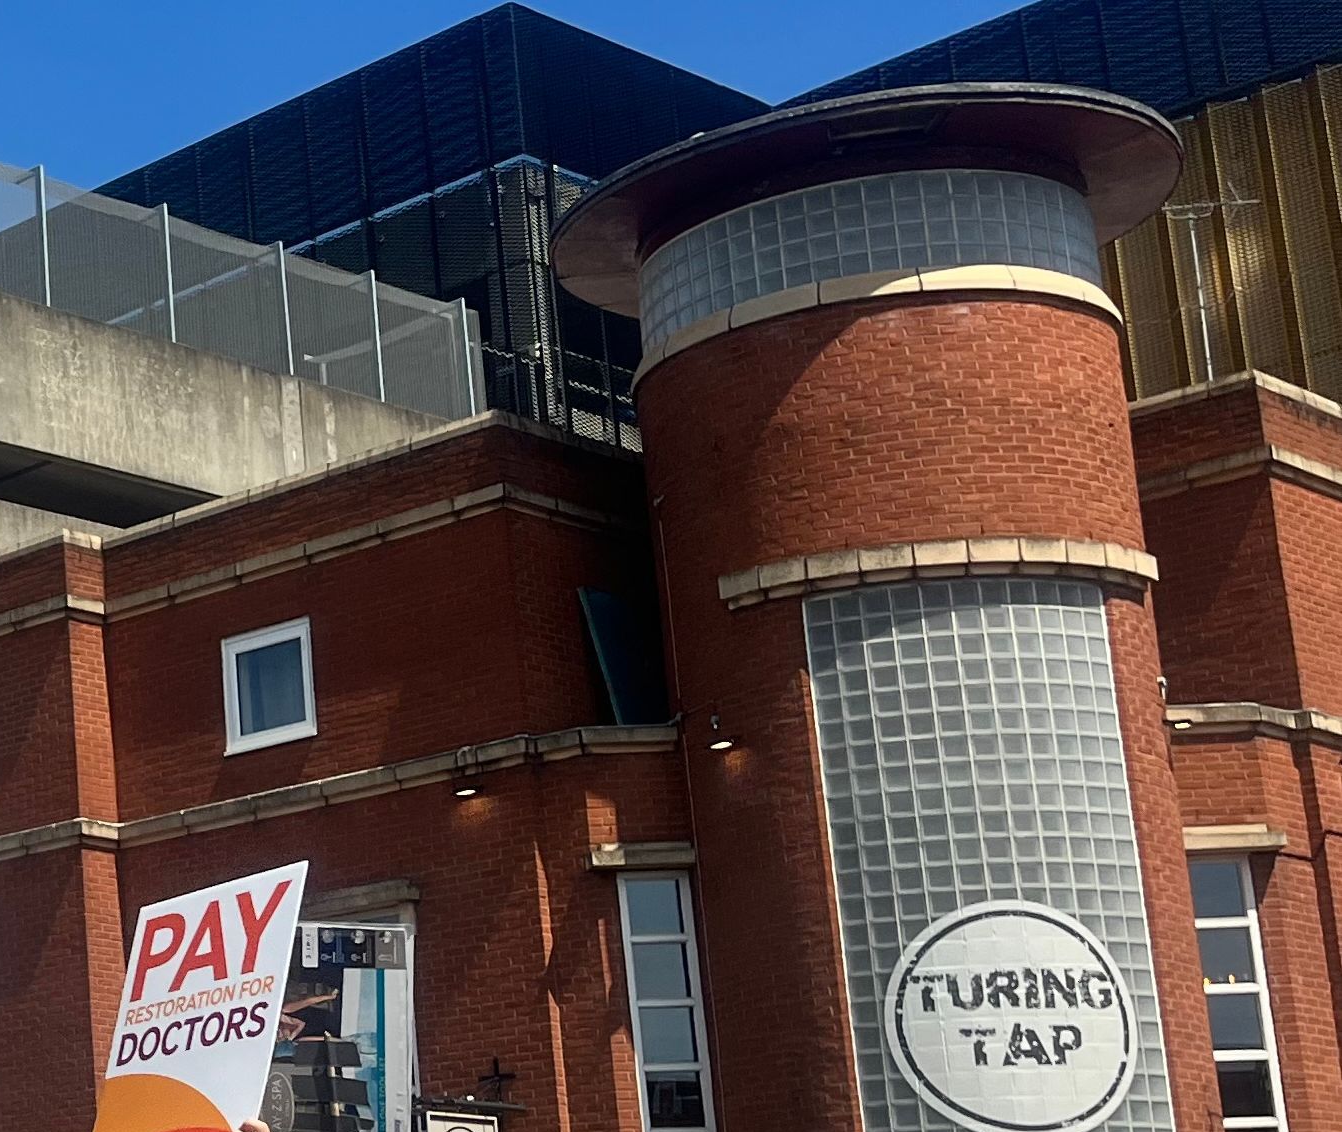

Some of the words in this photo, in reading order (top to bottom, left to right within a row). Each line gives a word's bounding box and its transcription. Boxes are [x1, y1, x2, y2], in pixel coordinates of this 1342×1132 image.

[130, 879, 293, 1003] PAY
[124, 984, 238, 1026] RESTORATION
[239, 975, 275, 999] FOR
[907, 968, 1113, 1013] TURING
[115, 1001, 269, 1067] DOCTORS
[959, 1023, 1082, 1066] TAP
